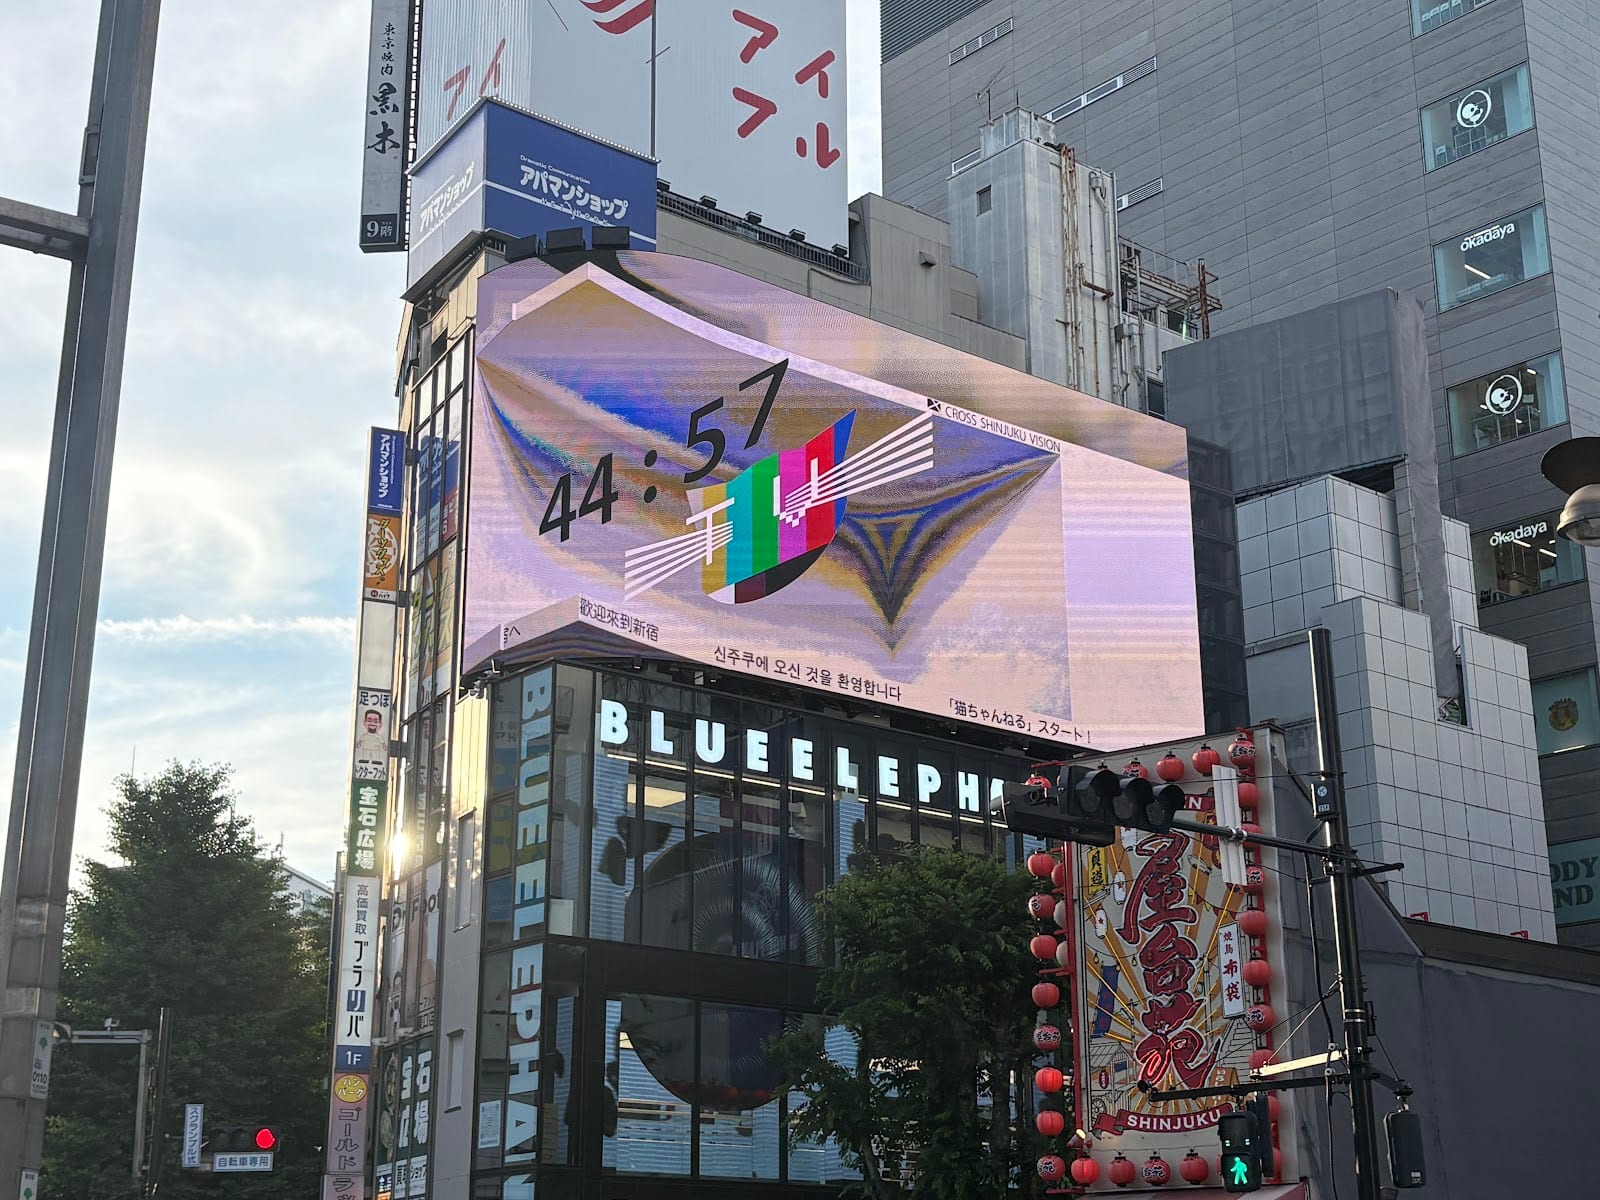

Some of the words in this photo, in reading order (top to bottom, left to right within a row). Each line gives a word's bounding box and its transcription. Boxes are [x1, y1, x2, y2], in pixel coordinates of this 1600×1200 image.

[367, 82, 400, 155] 黒木
[419, 161, 475, 233] アパマンショップ
[520, 164, 629, 220] アパマンショップ
[1460, 223, 1515, 252] okadaya
[539, 357, 789, 543] 44:57
[945, 405, 977, 426] CROSS
[980, 416, 1027, 442] SHINJUKU
[1029, 432, 1061, 453] VISION
[1489, 520, 1548, 548] okadaya
[714, 645, 769, 673] 신주쿠에
[773, 659, 801, 680] 오신
[805, 666, 833, 687] 것을
[837, 673, 902, 702] 환영합니다
[355, 786, 379, 870] 宝石広場
[355, 883, 369, 935] 高価買取
[346, 940, 369, 1038] ブラリバ
[1222, 958, 1241, 1003] 布袋
[346, 1051, 362, 1065] 1F
[187, 1107, 199, 1164] スクランブル式
[1127, 1108, 1221, 1130] SHINJUKU
[218, 1156, 269, 1168] 自転車専用
